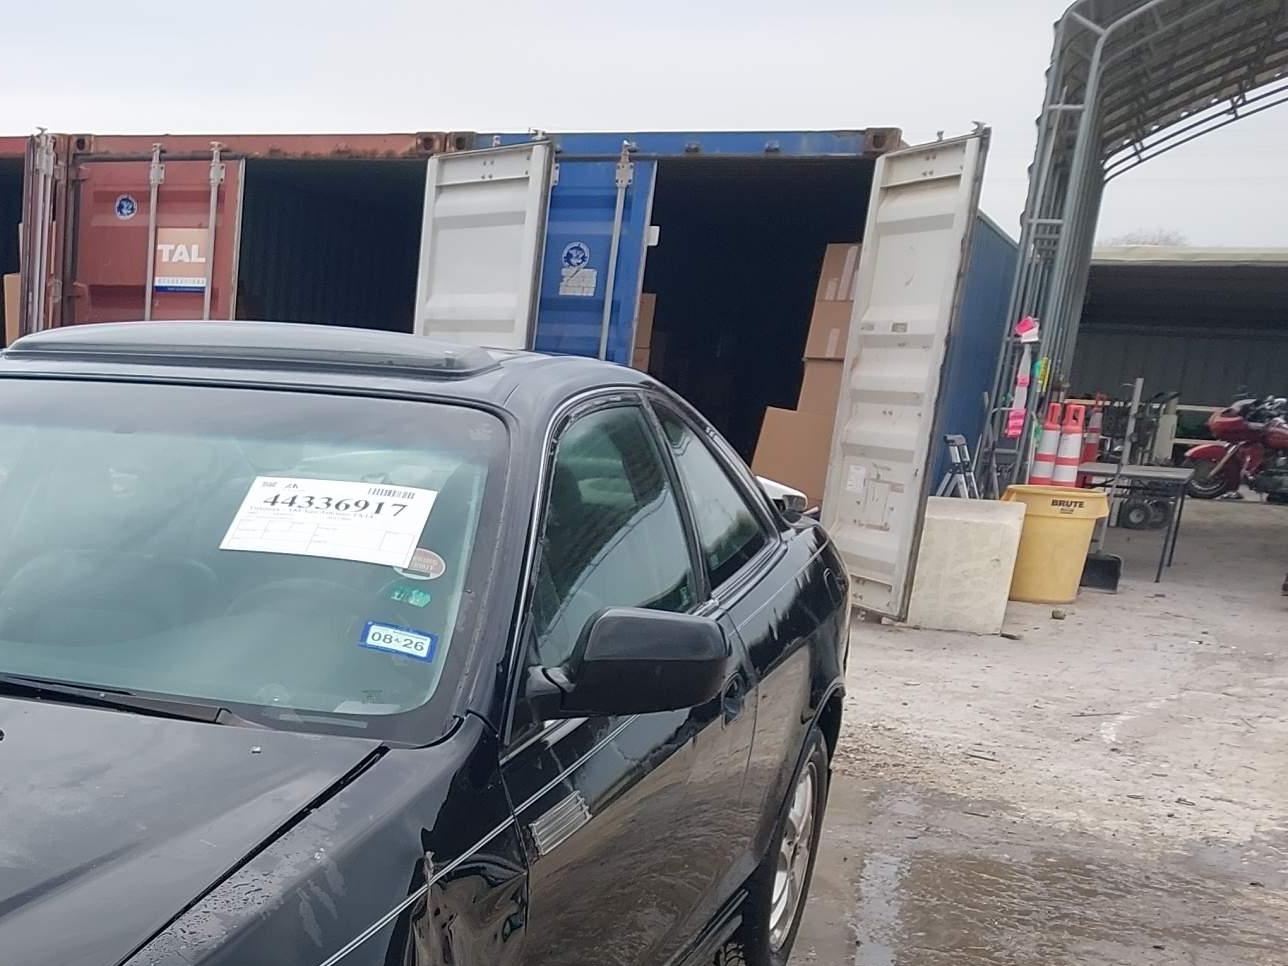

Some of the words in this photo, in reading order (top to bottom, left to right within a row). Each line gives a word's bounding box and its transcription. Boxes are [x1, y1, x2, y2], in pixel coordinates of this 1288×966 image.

[157, 244, 206, 263] TAL
[263, 493, 408, 518] 44336917
[1050, 499, 1085, 509] BRUTE
